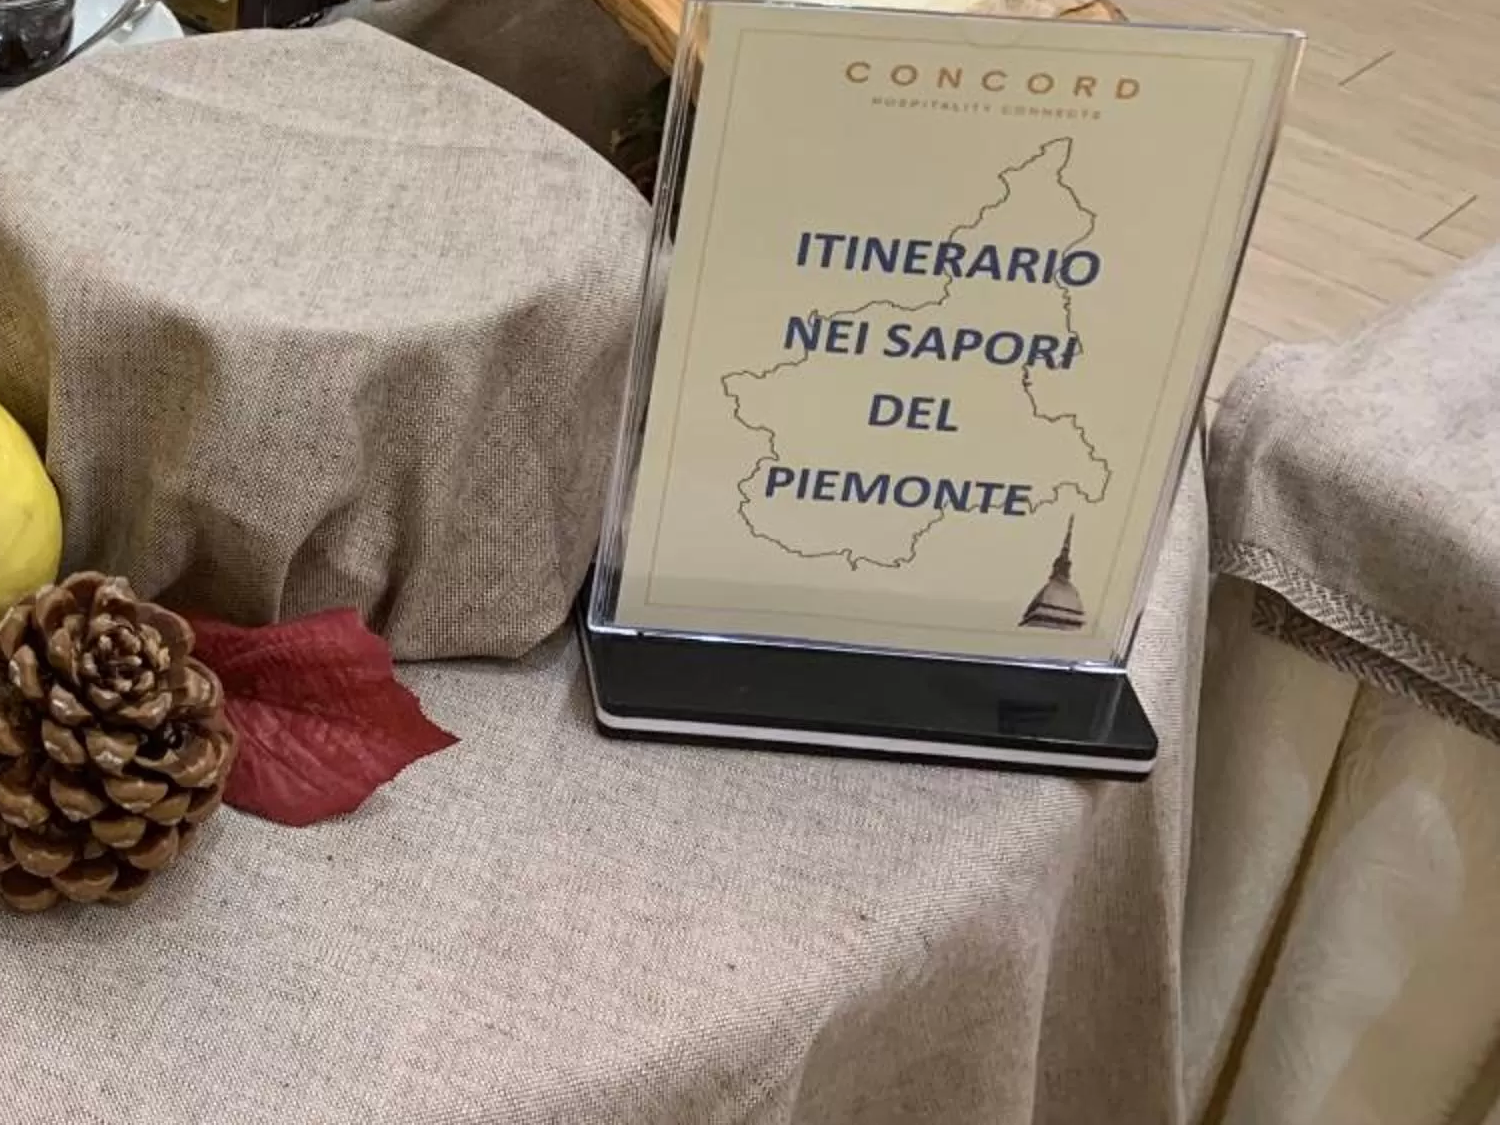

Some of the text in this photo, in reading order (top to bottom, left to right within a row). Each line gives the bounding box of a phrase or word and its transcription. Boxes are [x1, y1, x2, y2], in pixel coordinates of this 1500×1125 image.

[845, 61, 1141, 100] CONCORD
[796, 232, 1102, 287] ITINERARIO
[784, 317, 1077, 369] NEI SAPORI
[868, 394, 959, 432] DEL
[765, 466, 1033, 516] PIEMONTE
